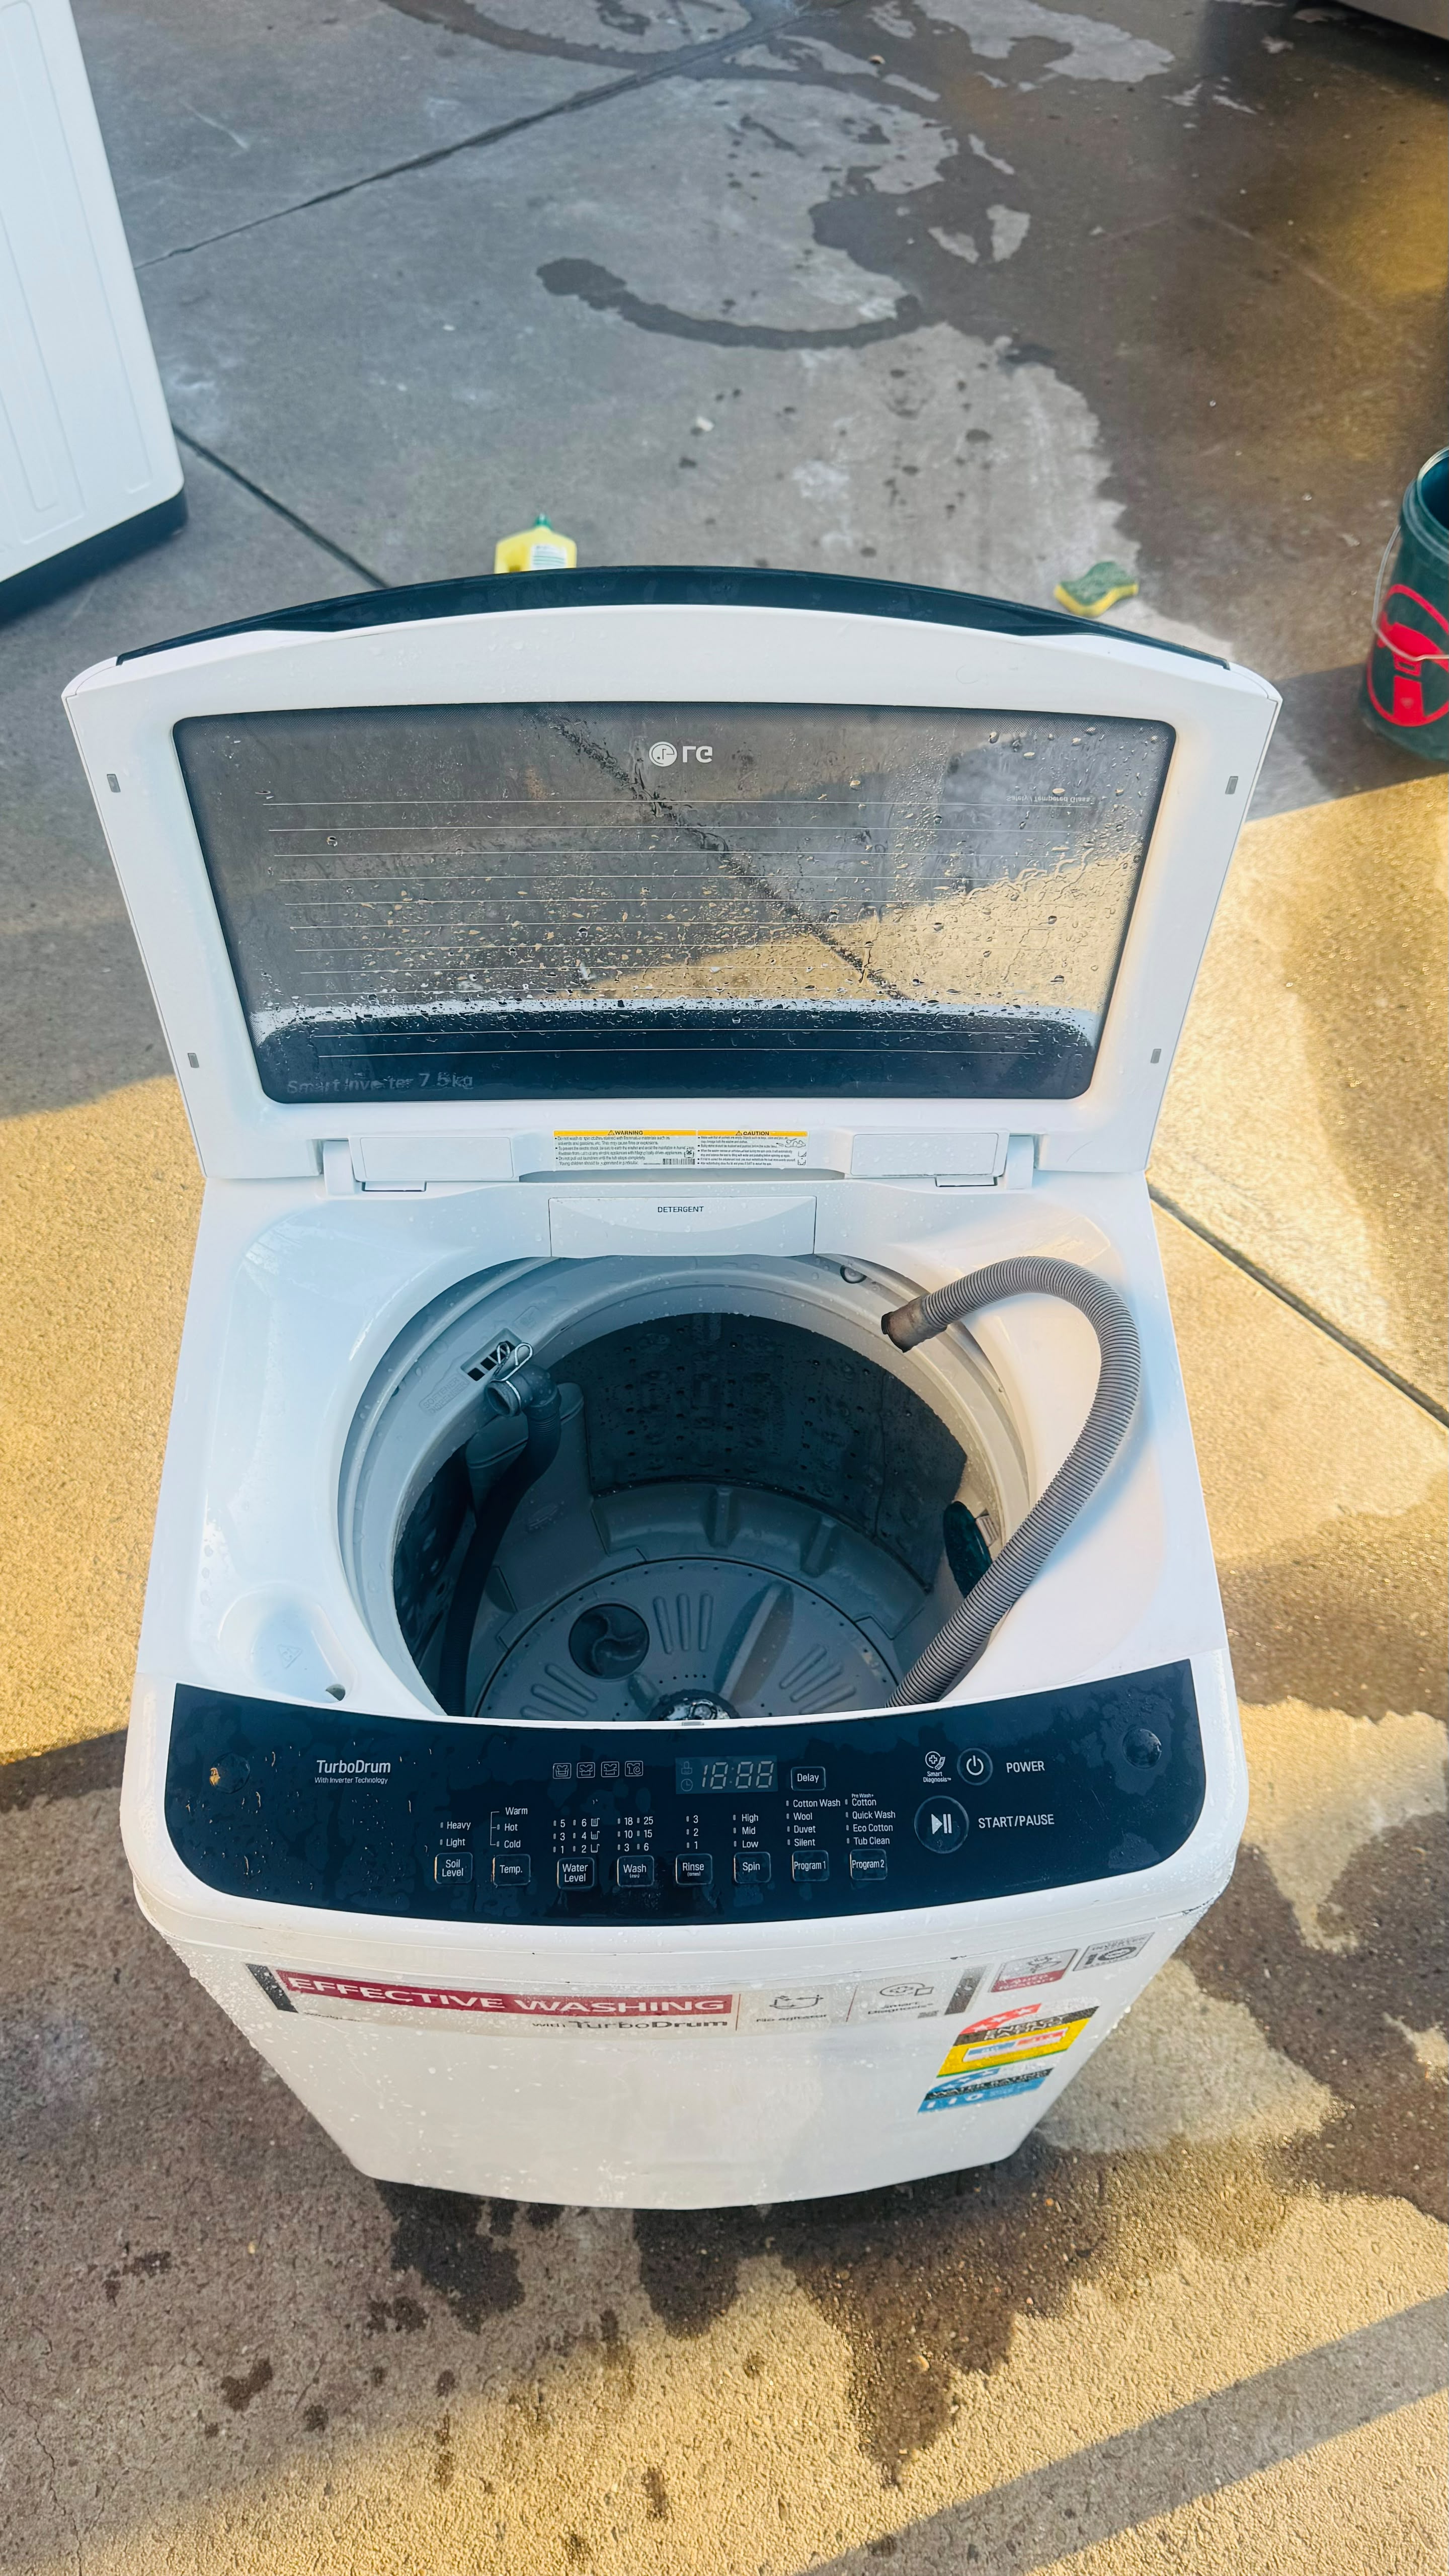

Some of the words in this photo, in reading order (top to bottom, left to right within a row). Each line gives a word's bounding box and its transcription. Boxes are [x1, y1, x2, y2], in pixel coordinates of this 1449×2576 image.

[287, 1079, 340, 1094] Smart
[316, 1759, 391, 1774] TurboDrum
[1006, 1760, 1045, 1773] POWER
[355, 1777, 388, 1785] Technology
[797, 1773, 819, 1784] Delay
[793, 1799, 818, 1808] Cotton
[819, 1799, 841, 1807] Wash
[852, 1797, 876, 1806] Cotton
[505, 1807, 528, 1815] Warm
[852, 1811, 873, 1820] Quick
[874, 1810, 896, 1819] Wash
[643, 1816, 654, 1825] 25
[693, 1815, 698, 1823] 3
[742, 1813, 759, 1823] High
[793, 1812, 813, 1820] Wool
[447, 1821, 471, 1830] Heavy
[560, 1819, 566, 1828] 5
[582, 1818, 587, 1827] 6
[624, 1817, 633, 1825] 18
[978, 1814, 1055, 1829] START/PAUSE
[504, 1823, 518, 1831] Hot
[742, 1826, 756, 1835] Mid
[793, 1825, 816, 1833] Duvet
[853, 1824, 867, 1832] Eco
[868, 1823, 893, 1832] Cotton
[560, 1832, 566, 1841] 3
[581, 1831, 587, 1840] 4
[624, 1830, 633, 1838] 10
[643, 1829, 653, 1838] 15
[693, 1828, 699, 1836] 2
[446, 1838, 465, 1848] Light
[504, 1839, 521, 1848] Cold
[694, 1841, 698, 1849] 1
[742, 1840, 759, 1848] Low
[794, 1838, 816, 1846] Silent
[853, 1837, 868, 1845] Tub
[869, 1836, 890, 1845] Clean
[560, 1845, 564, 1854] 1
[581, 1844, 587, 1853] 2
[624, 1843, 629, 1852] 3
[643, 1842, 649, 1851] 6
[445, 1859, 460, 1868] Soil
[562, 1863, 588, 1873] Water
[682, 1862, 704, 1871] Rinse
[743, 1862, 760, 1873] Spin
[794, 1861, 821, 1871] Program
[823, 1861, 826, 1869] 1
[852, 1860, 879, 1870] Program
[880, 1859, 884, 1868] 2
[442, 1868, 464, 1877] Level
[499, 1865, 523, 1875] Temp.
[623, 1864, 647, 1873] Wash
[564, 1873, 586, 1883] Level
[287, 1977, 505, 2009] EFFECTIVE
[514, 1999, 724, 2013] WASHING
[568, 2021, 728, 2029] TurboDrum
[986, 2014, 1070, 2034] ENERGY
